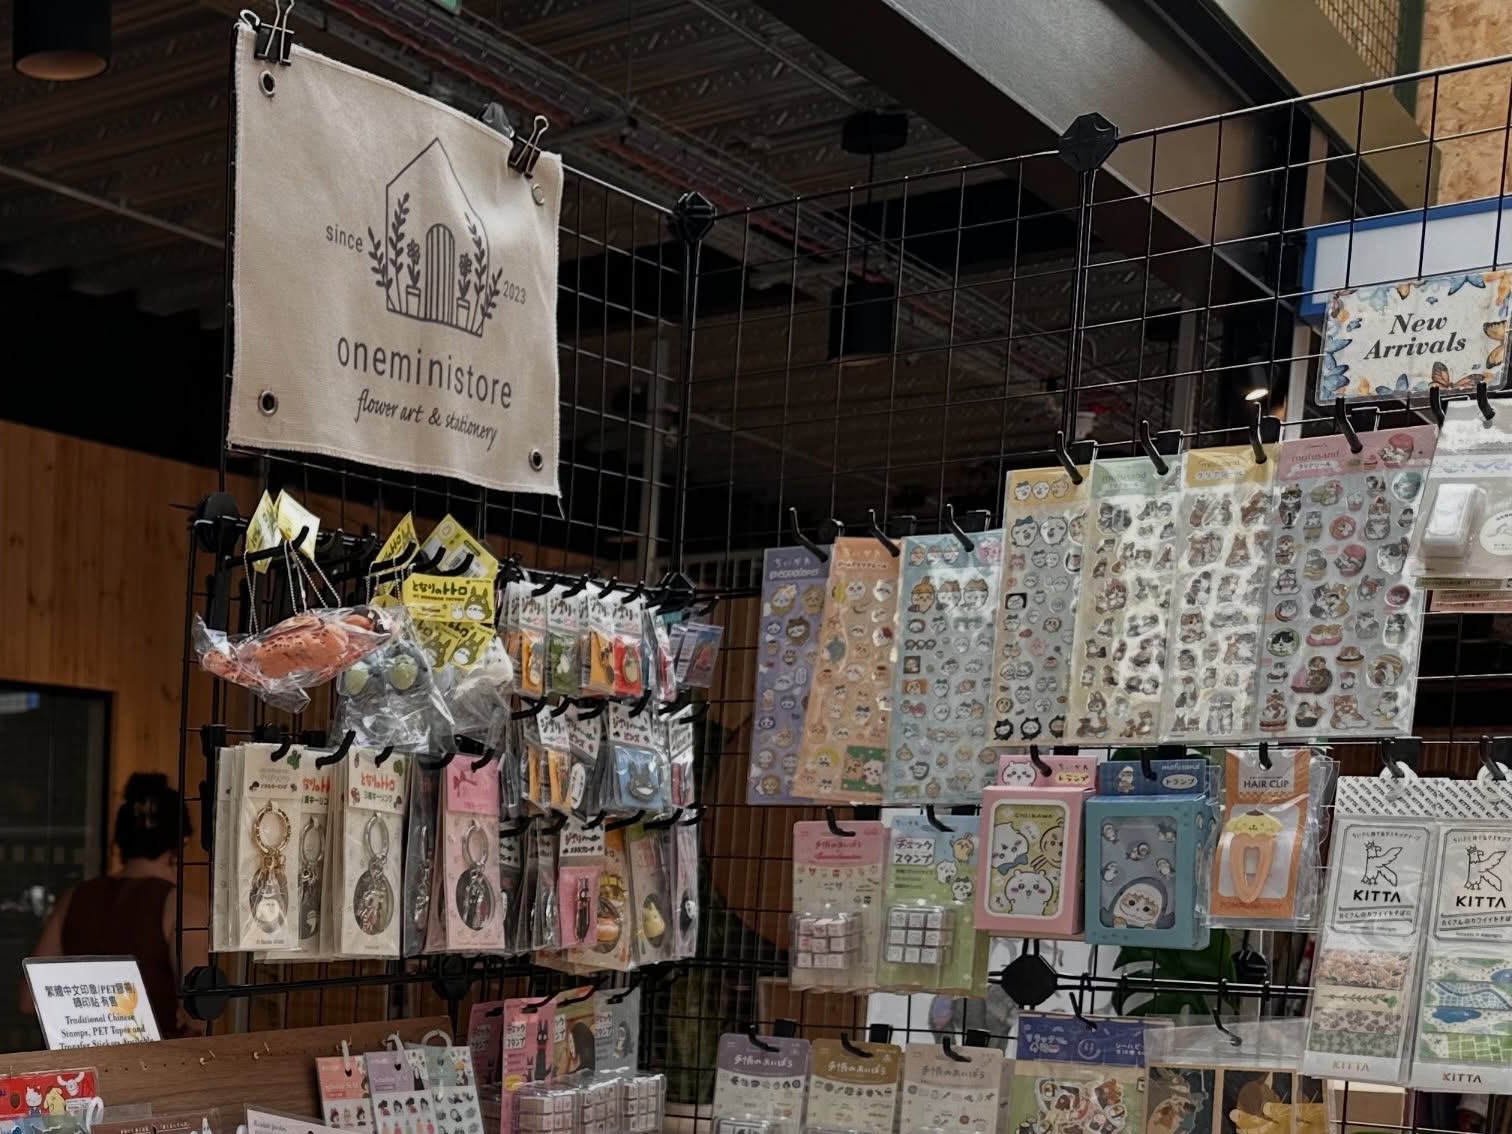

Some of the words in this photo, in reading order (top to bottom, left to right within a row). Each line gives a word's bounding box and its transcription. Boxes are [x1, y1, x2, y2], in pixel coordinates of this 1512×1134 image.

[325, 223, 363, 253] since
[503, 279, 526, 305] 2023
[1389, 313, 1448, 335] New
[1363, 331, 1467, 360] Arrivals
[337, 336, 513, 409] oneministore
[355, 388, 397, 424] flower
[400, 404, 424, 424] art
[428, 411, 442, 427] &
[445, 411, 498, 451] stationery
[1291, 450, 1340, 463] mofusand
[1165, 776, 1196, 786] トランプ
[1243, 779, 1267, 789] HAIR
[1269, 780, 1290, 789] CLIP
[895, 838, 932, 850] チェック
[894, 853, 933, 864] スタンプ
[1353, 889, 1401, 903] KITTA
[1455, 895, 1507, 909] KITTA
[64, 1015, 106, 1025] Traditional
[107, 1013, 135, 1023] Chinese
[61, 1029, 91, 1039] Stamps,
[93, 1026, 109, 1035] PET
[111, 1026, 132, 1036] Tapes
[132, 1024, 146, 1033] and
